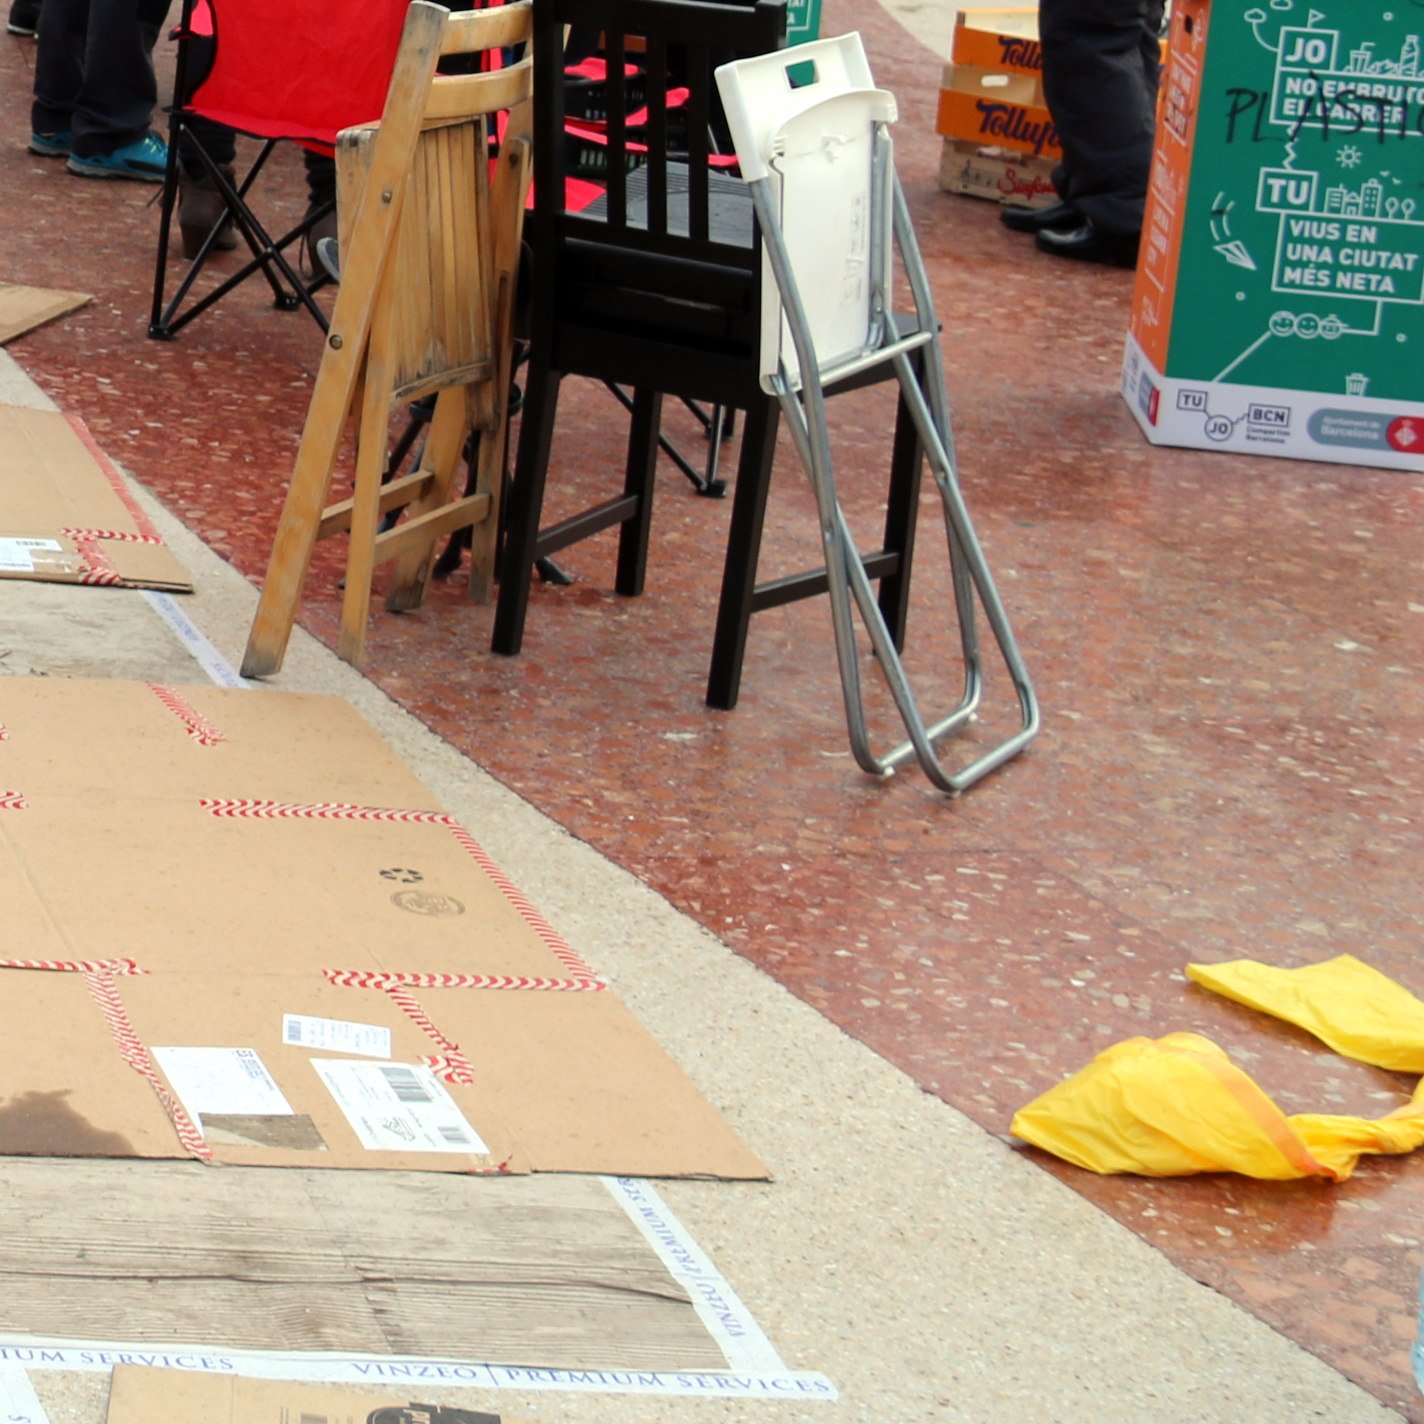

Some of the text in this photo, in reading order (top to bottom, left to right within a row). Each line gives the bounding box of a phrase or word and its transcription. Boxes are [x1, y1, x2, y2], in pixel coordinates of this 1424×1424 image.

[1285, 37, 1327, 64] JO
[1285, 77, 1318, 96] NO
[1266, 177, 1310, 205] TU
[1289, 218, 1378, 244] VIUS EN
[1286, 242, 1419, 272] UNA CIUTAT
[1282, 262, 1395, 294] MÉS NETA
[1182, 393, 1203, 407] TU
[1212, 421, 1228, 435] JO
[1253, 409, 1286, 424] BCN
[1320, 424, 1380, 441] Barcelona
[80, 1350, 235, 1372] SERVICES
[351, 1362, 832, 1394] VINZEO PREMIUM SERVICES
